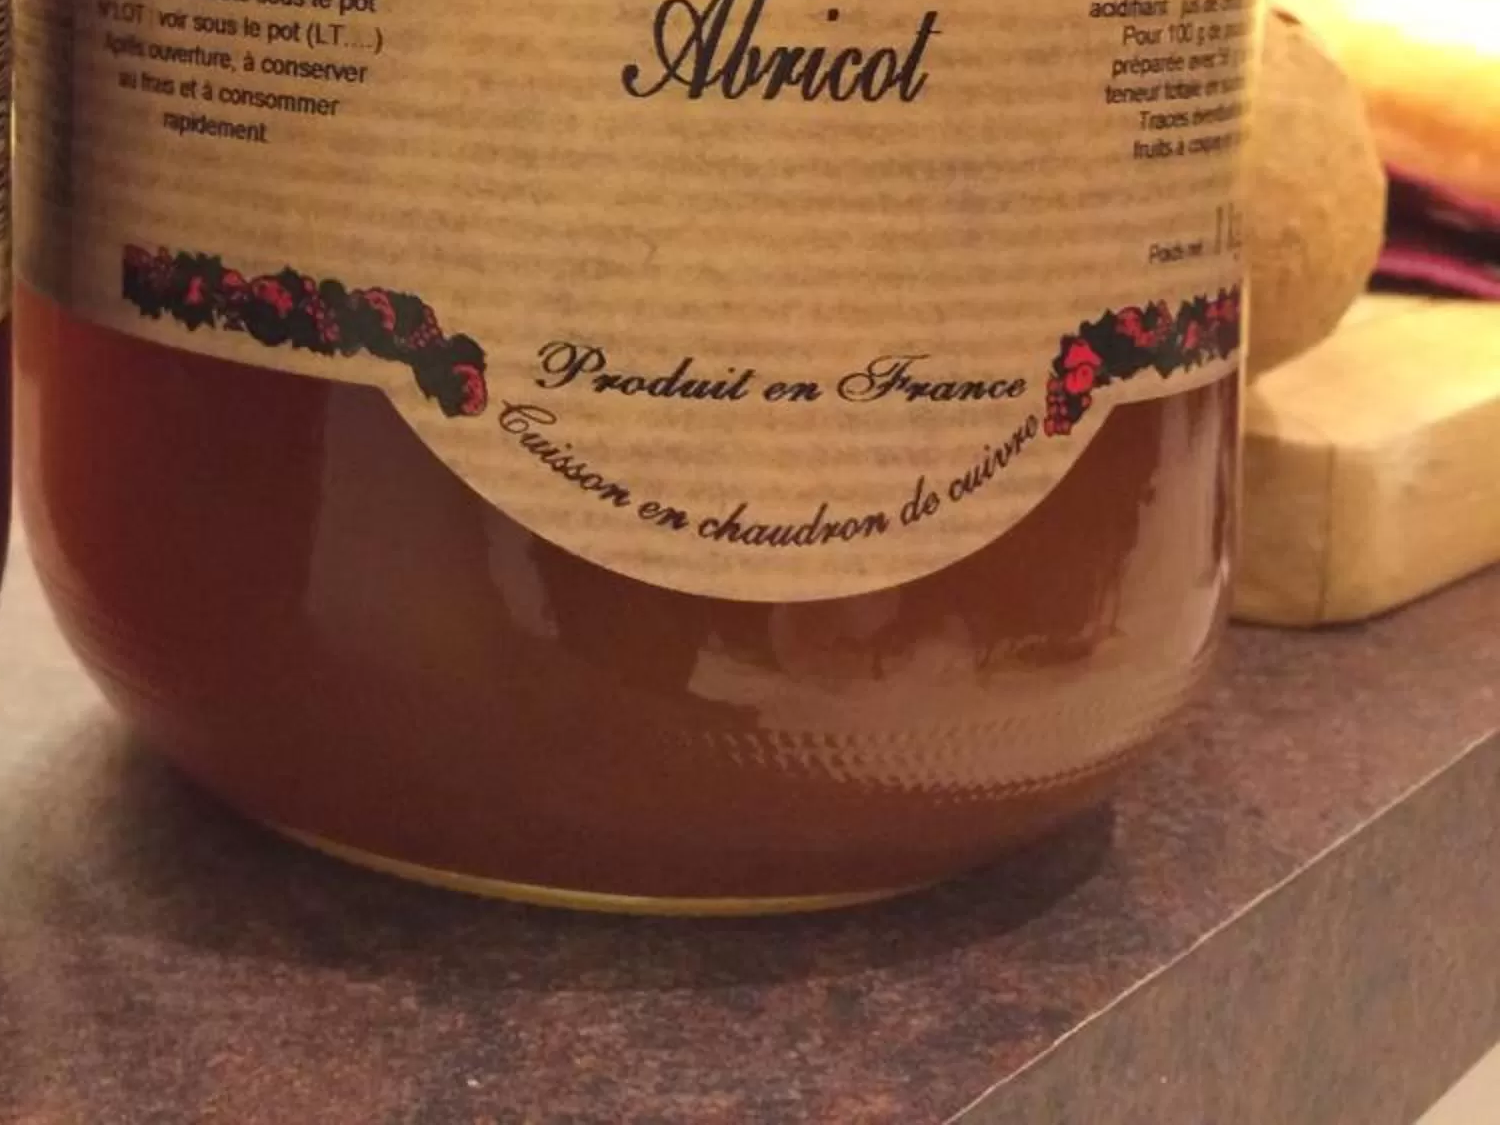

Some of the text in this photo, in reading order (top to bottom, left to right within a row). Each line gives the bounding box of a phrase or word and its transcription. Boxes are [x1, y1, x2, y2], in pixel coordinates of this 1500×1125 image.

[158, 9, 188, 29] voir
[193, 15, 238, 36] sous
[243, 16, 261, 39] le
[267, 20, 300, 44] pot
[242, 52, 256, 72] à
[261, 54, 368, 84] conserver
[180, 79, 199, 100] et
[219, 85, 341, 117] consommer
[163, 110, 268, 144] rapidement
[536, 341, 1027, 404] Produit en France
[498, 398, 1040, 549] Cuisson en chaudron de cuivre
